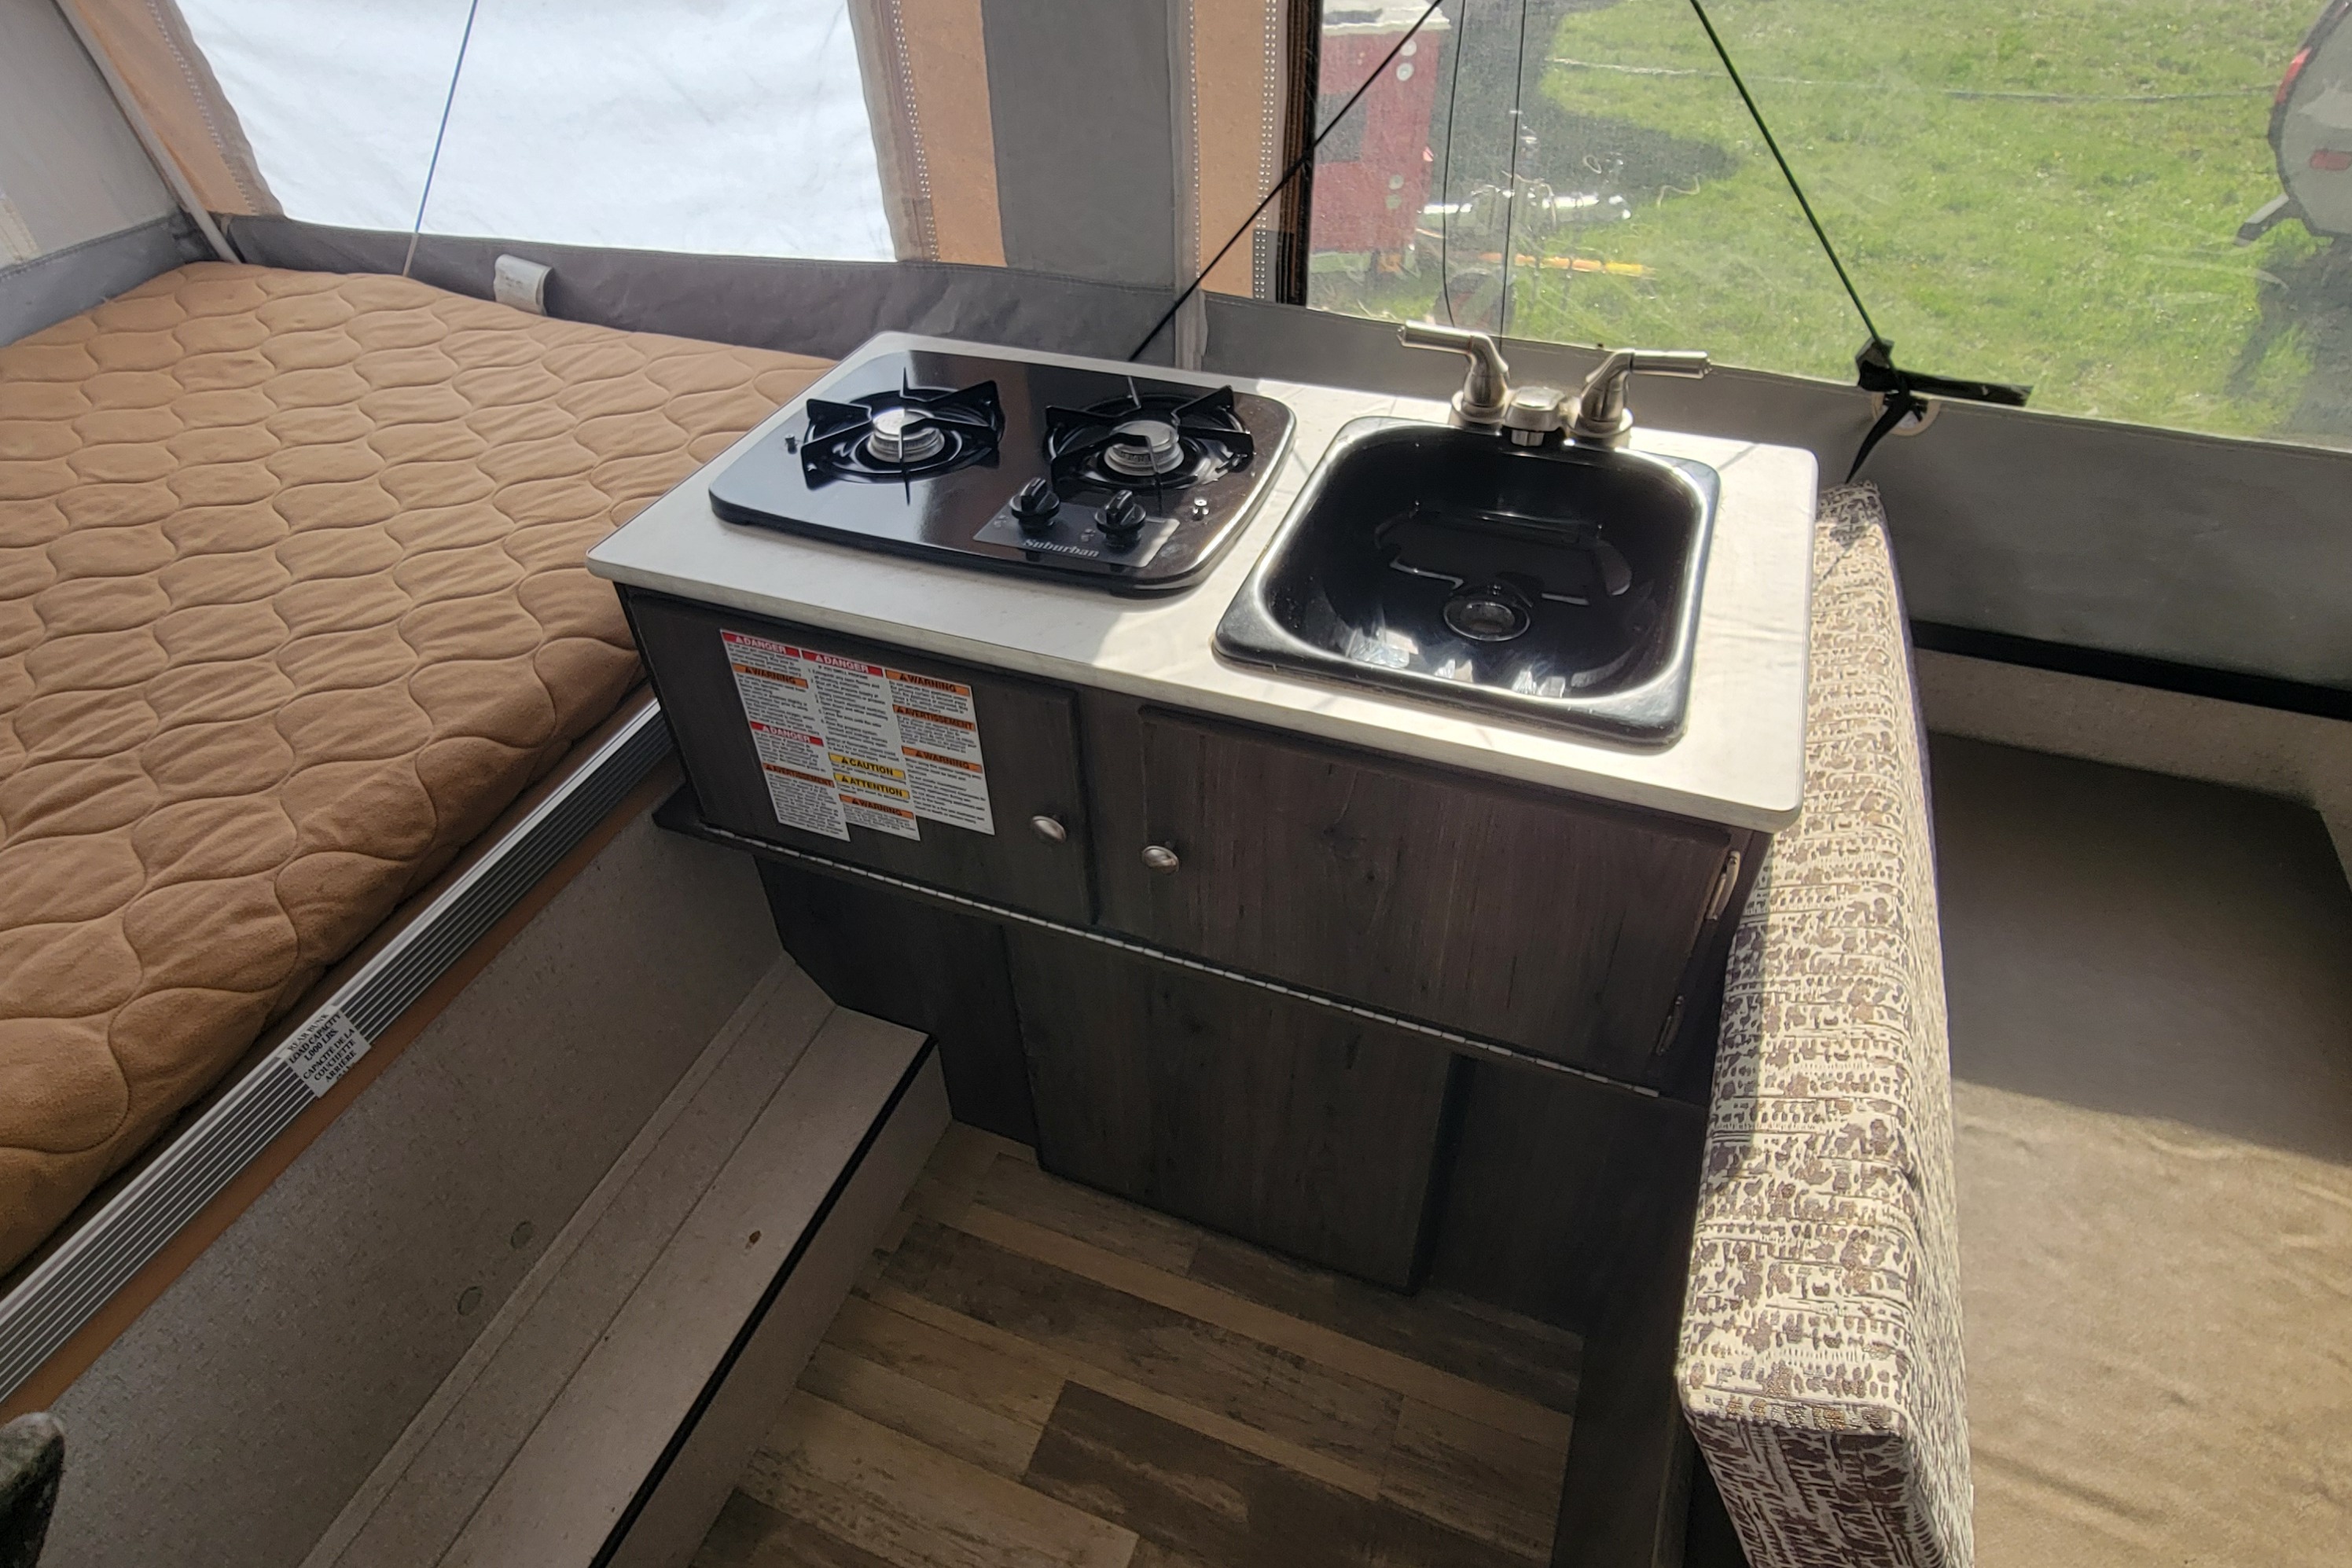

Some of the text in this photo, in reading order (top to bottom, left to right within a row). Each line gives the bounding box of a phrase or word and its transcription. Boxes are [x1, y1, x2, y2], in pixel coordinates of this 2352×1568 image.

[1023, 538, 1100, 557] Suburban
[743, 637, 786, 654] DANGER
[823, 656, 869, 673] DANGER
[751, 666, 796, 685] WARNING
[907, 674, 956, 692] WARNING
[770, 727, 810, 743] DANGER
[848, 758, 893, 776] CAUTION
[922, 751, 969, 769] WARNING
[848, 777, 902, 796] ATTENTION
[858, 799, 902, 816] WARNING
[288, 1012, 341, 1063] LOAD CAPACITY
[333, 1037, 345, 1048] DE
[344, 1028, 355, 1039] LA
[314, 1039, 355, 1081] COUCHETTE
